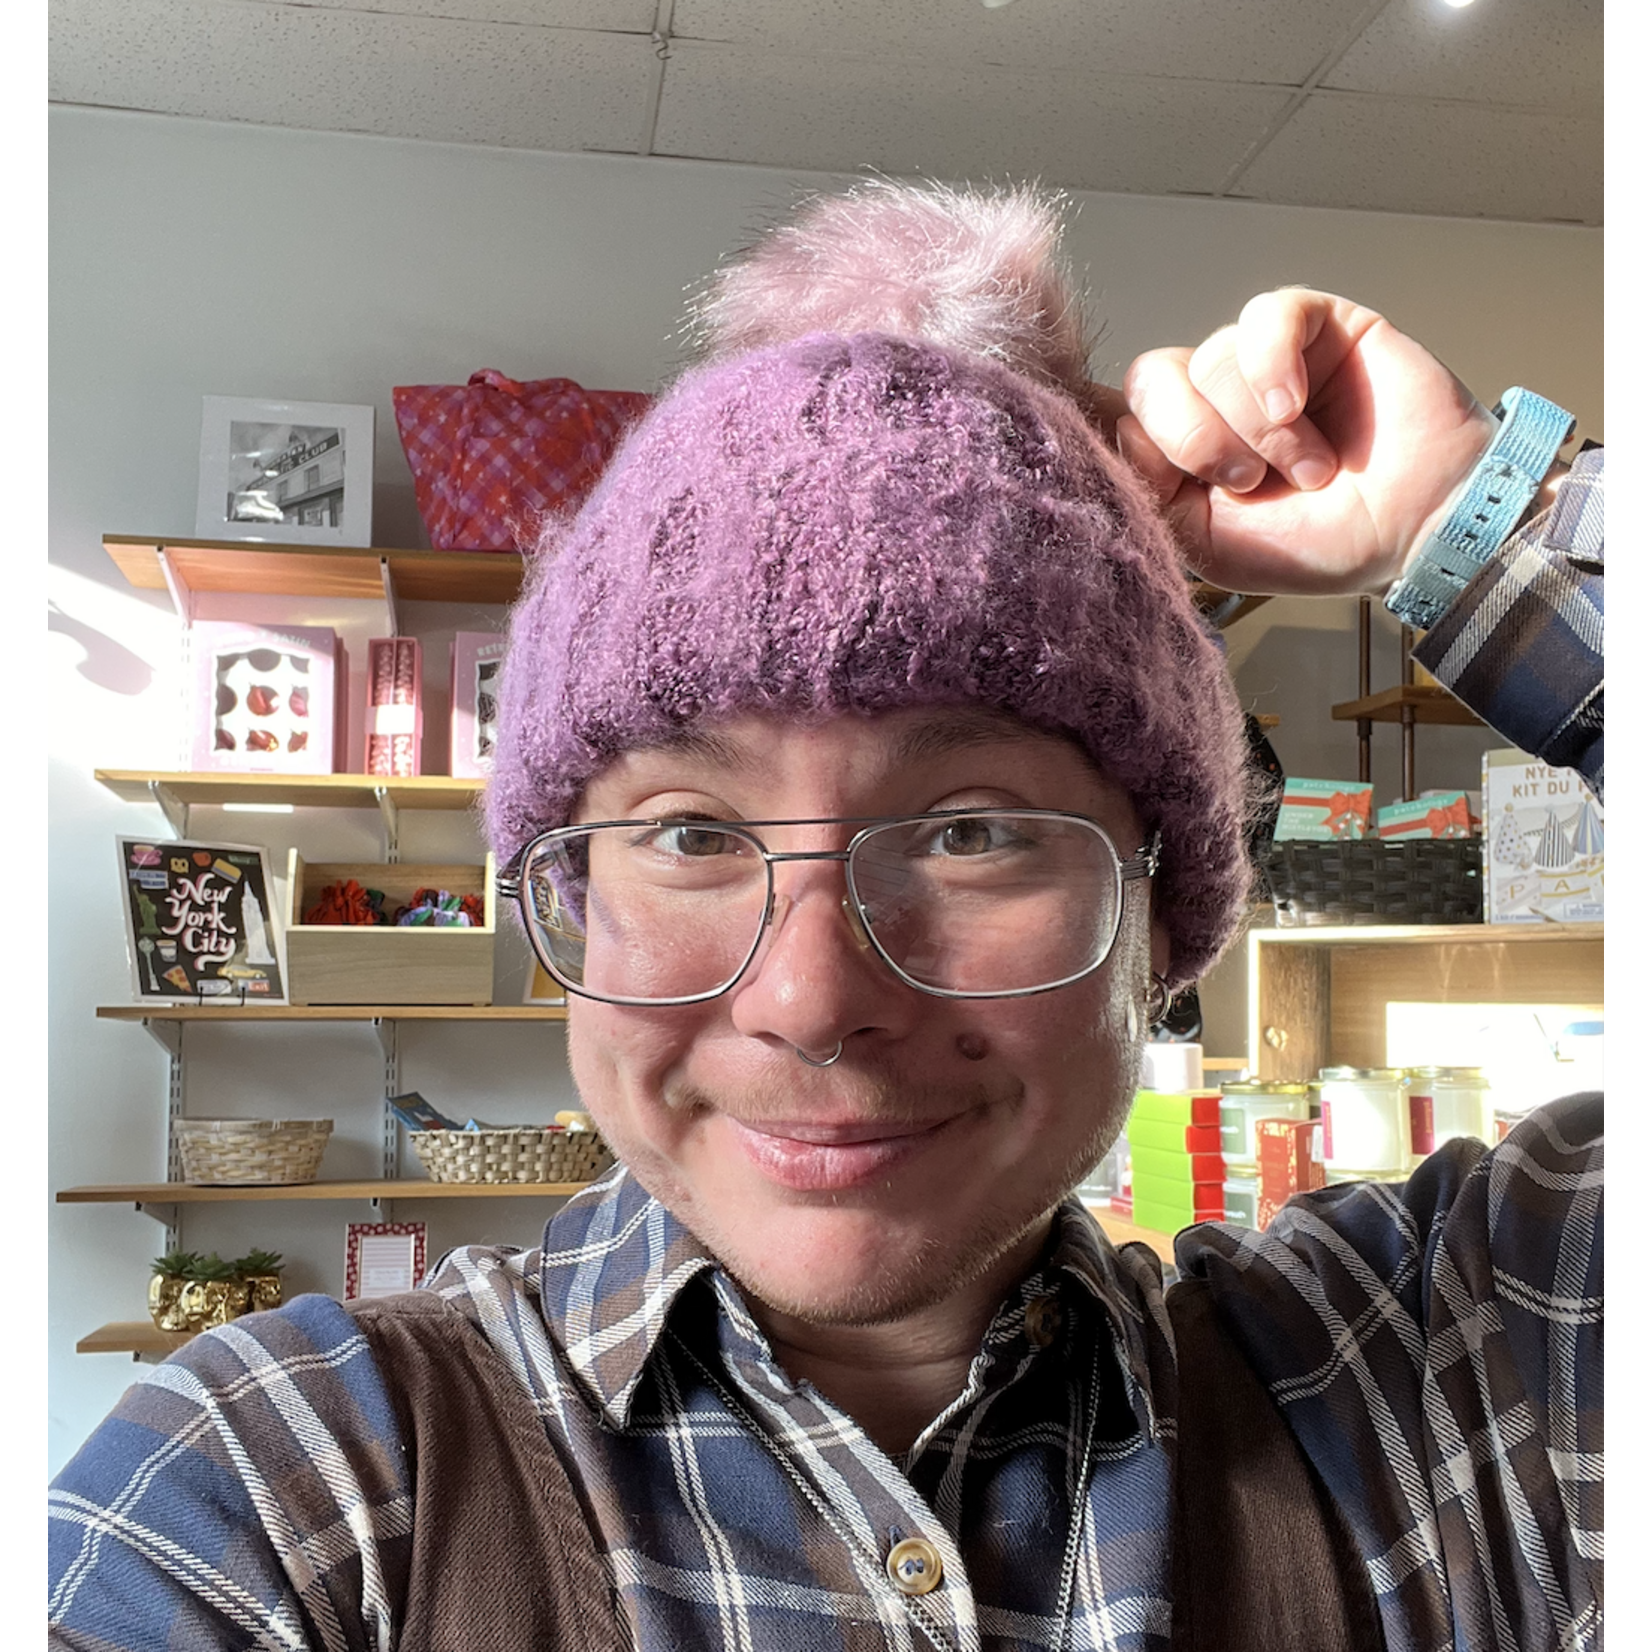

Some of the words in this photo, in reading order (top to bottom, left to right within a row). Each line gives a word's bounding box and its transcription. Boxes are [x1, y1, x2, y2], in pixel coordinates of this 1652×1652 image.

[298, 442, 328, 464] CLUB
[1525, 765, 1558, 779] NYE
[1512, 783, 1539, 797] KIT
[1547, 781, 1569, 795] DU
[171, 873, 232, 905] New
[162, 897, 237, 935] York
[183, 927, 236, 971] City
